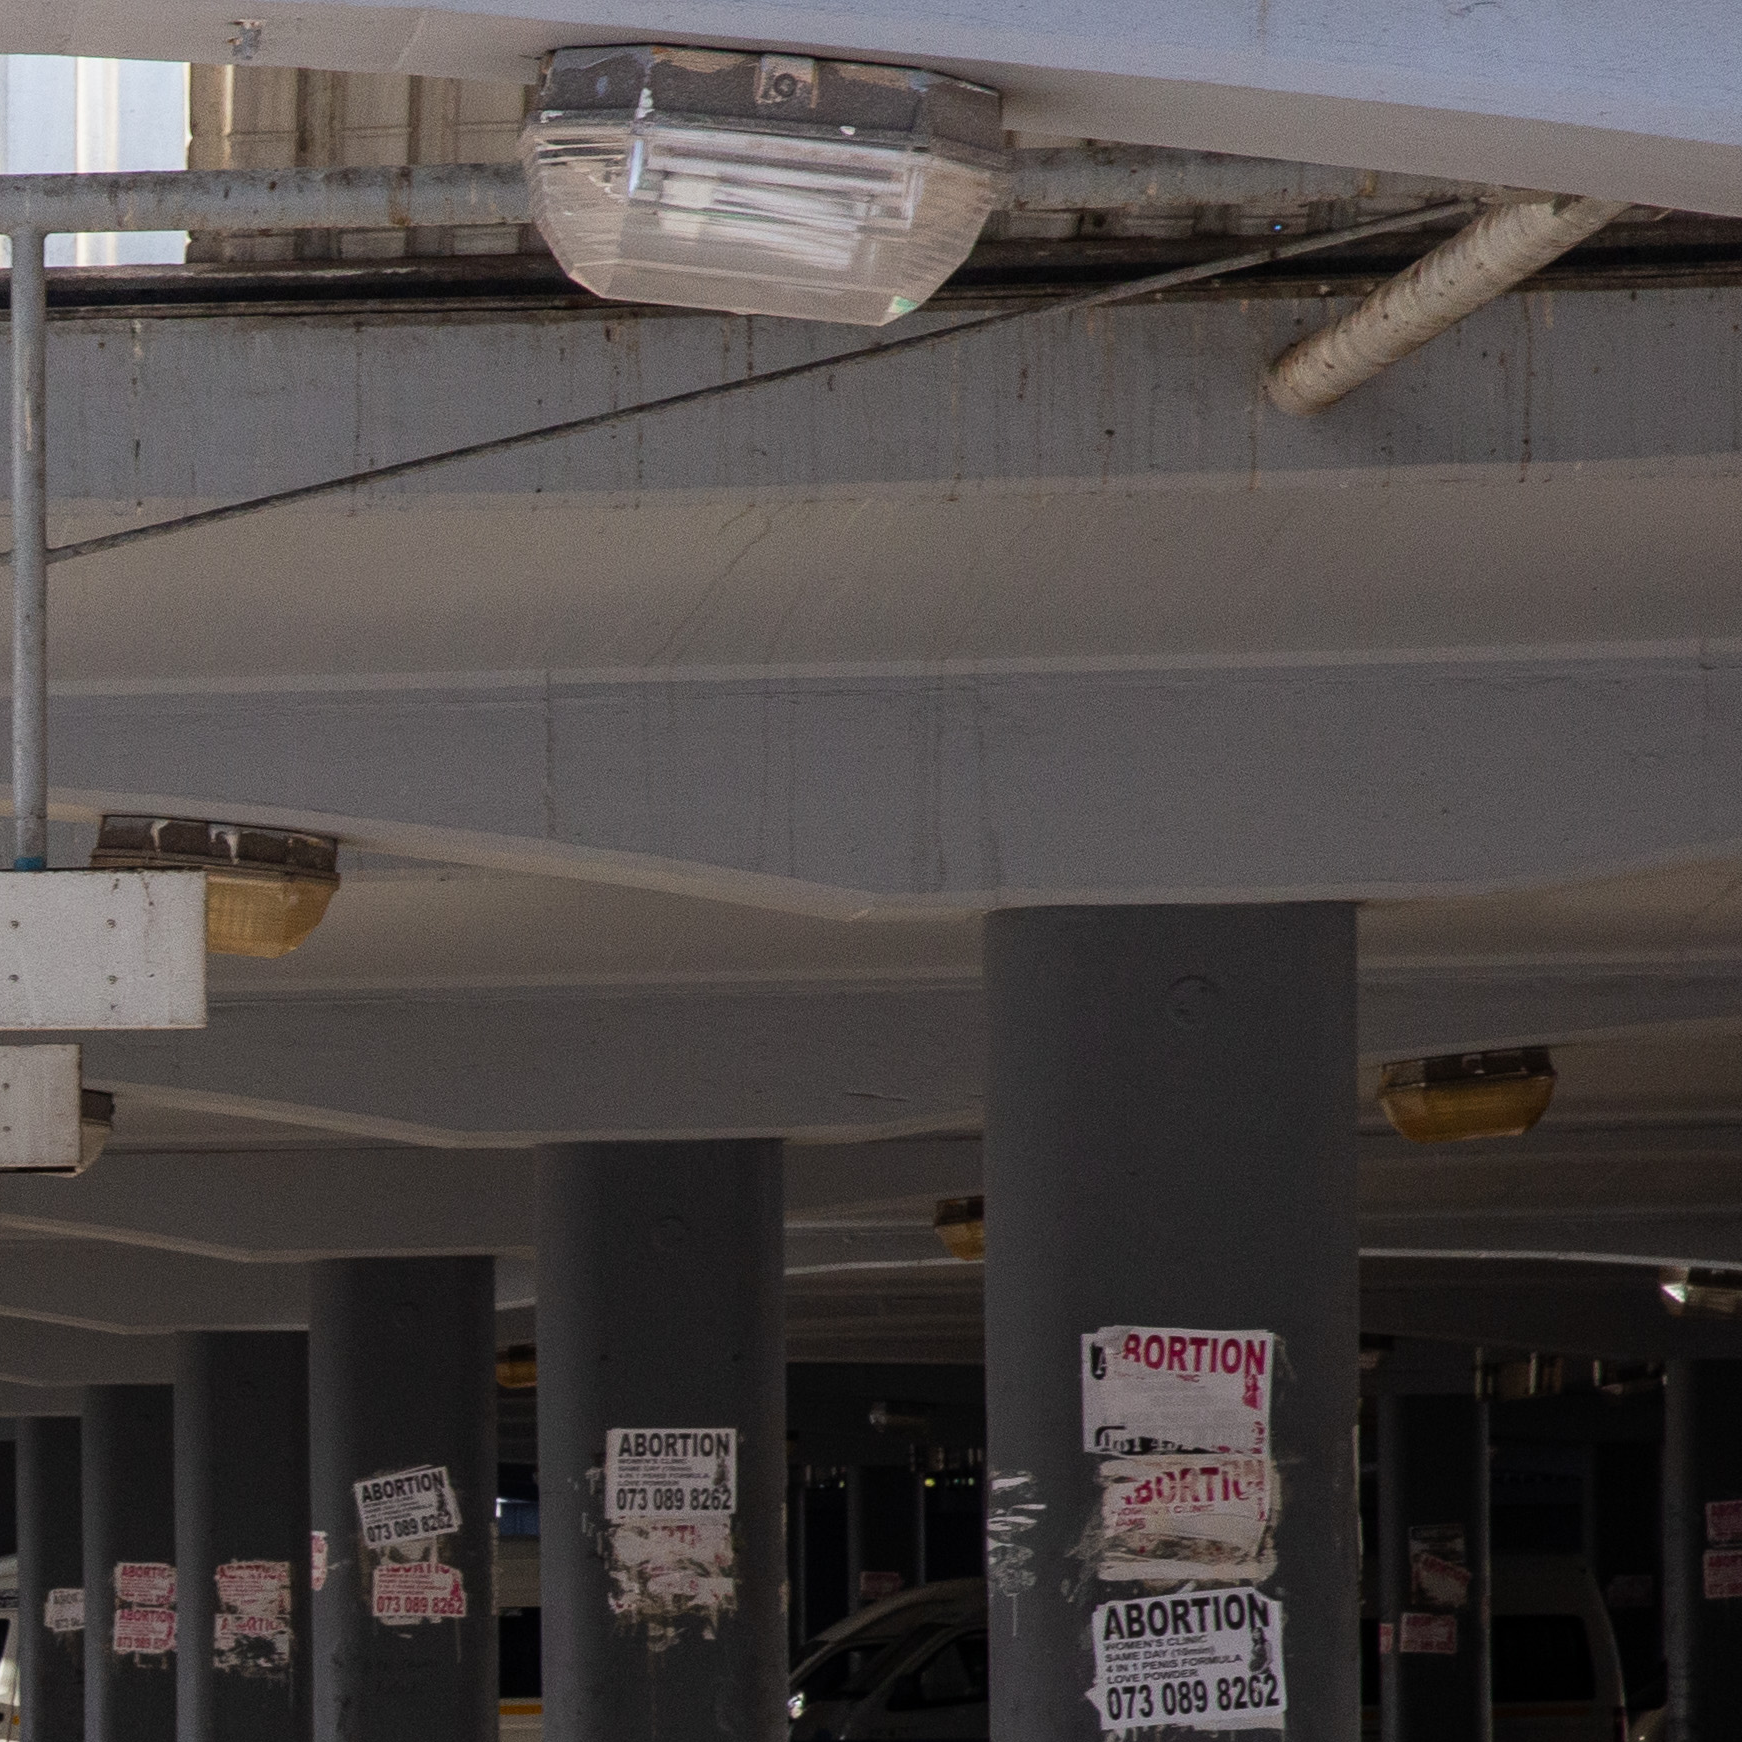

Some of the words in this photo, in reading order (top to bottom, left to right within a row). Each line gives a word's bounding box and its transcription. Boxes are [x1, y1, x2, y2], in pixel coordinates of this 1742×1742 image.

[1121, 1333, 1267, 1376] BORTION
[618, 1432, 731, 1458] ABORTION
[362, 1471, 445, 1503] ABORTION
[617, 1487, 648, 1511] 073
[653, 1487, 685, 1511] 089
[690, 1487, 732, 1511] 8262
[367, 1523, 392, 1543] 073
[393, 1518, 418, 1538] 089
[1103, 1593, 1270, 1641] ABORTION
[1104, 1638, 1164, 1651] WOMEN'S
[1167, 1634, 1207, 1647] CLINIC
[1104, 1651, 1141, 1663] SAME
[1143, 1649, 1168, 1660] DAY
[1141, 1658, 1179, 1671] PENIS
[1181, 1654, 1243, 1668] FORMULA
[1107, 1673, 1141, 1685] LOVE
[1143, 1668, 1199, 1682] POWDER
[1106, 1684, 1154, 1721] 073
[1161, 1679, 1209, 1716] 089
[1217, 1673, 1280, 1711] 8262
